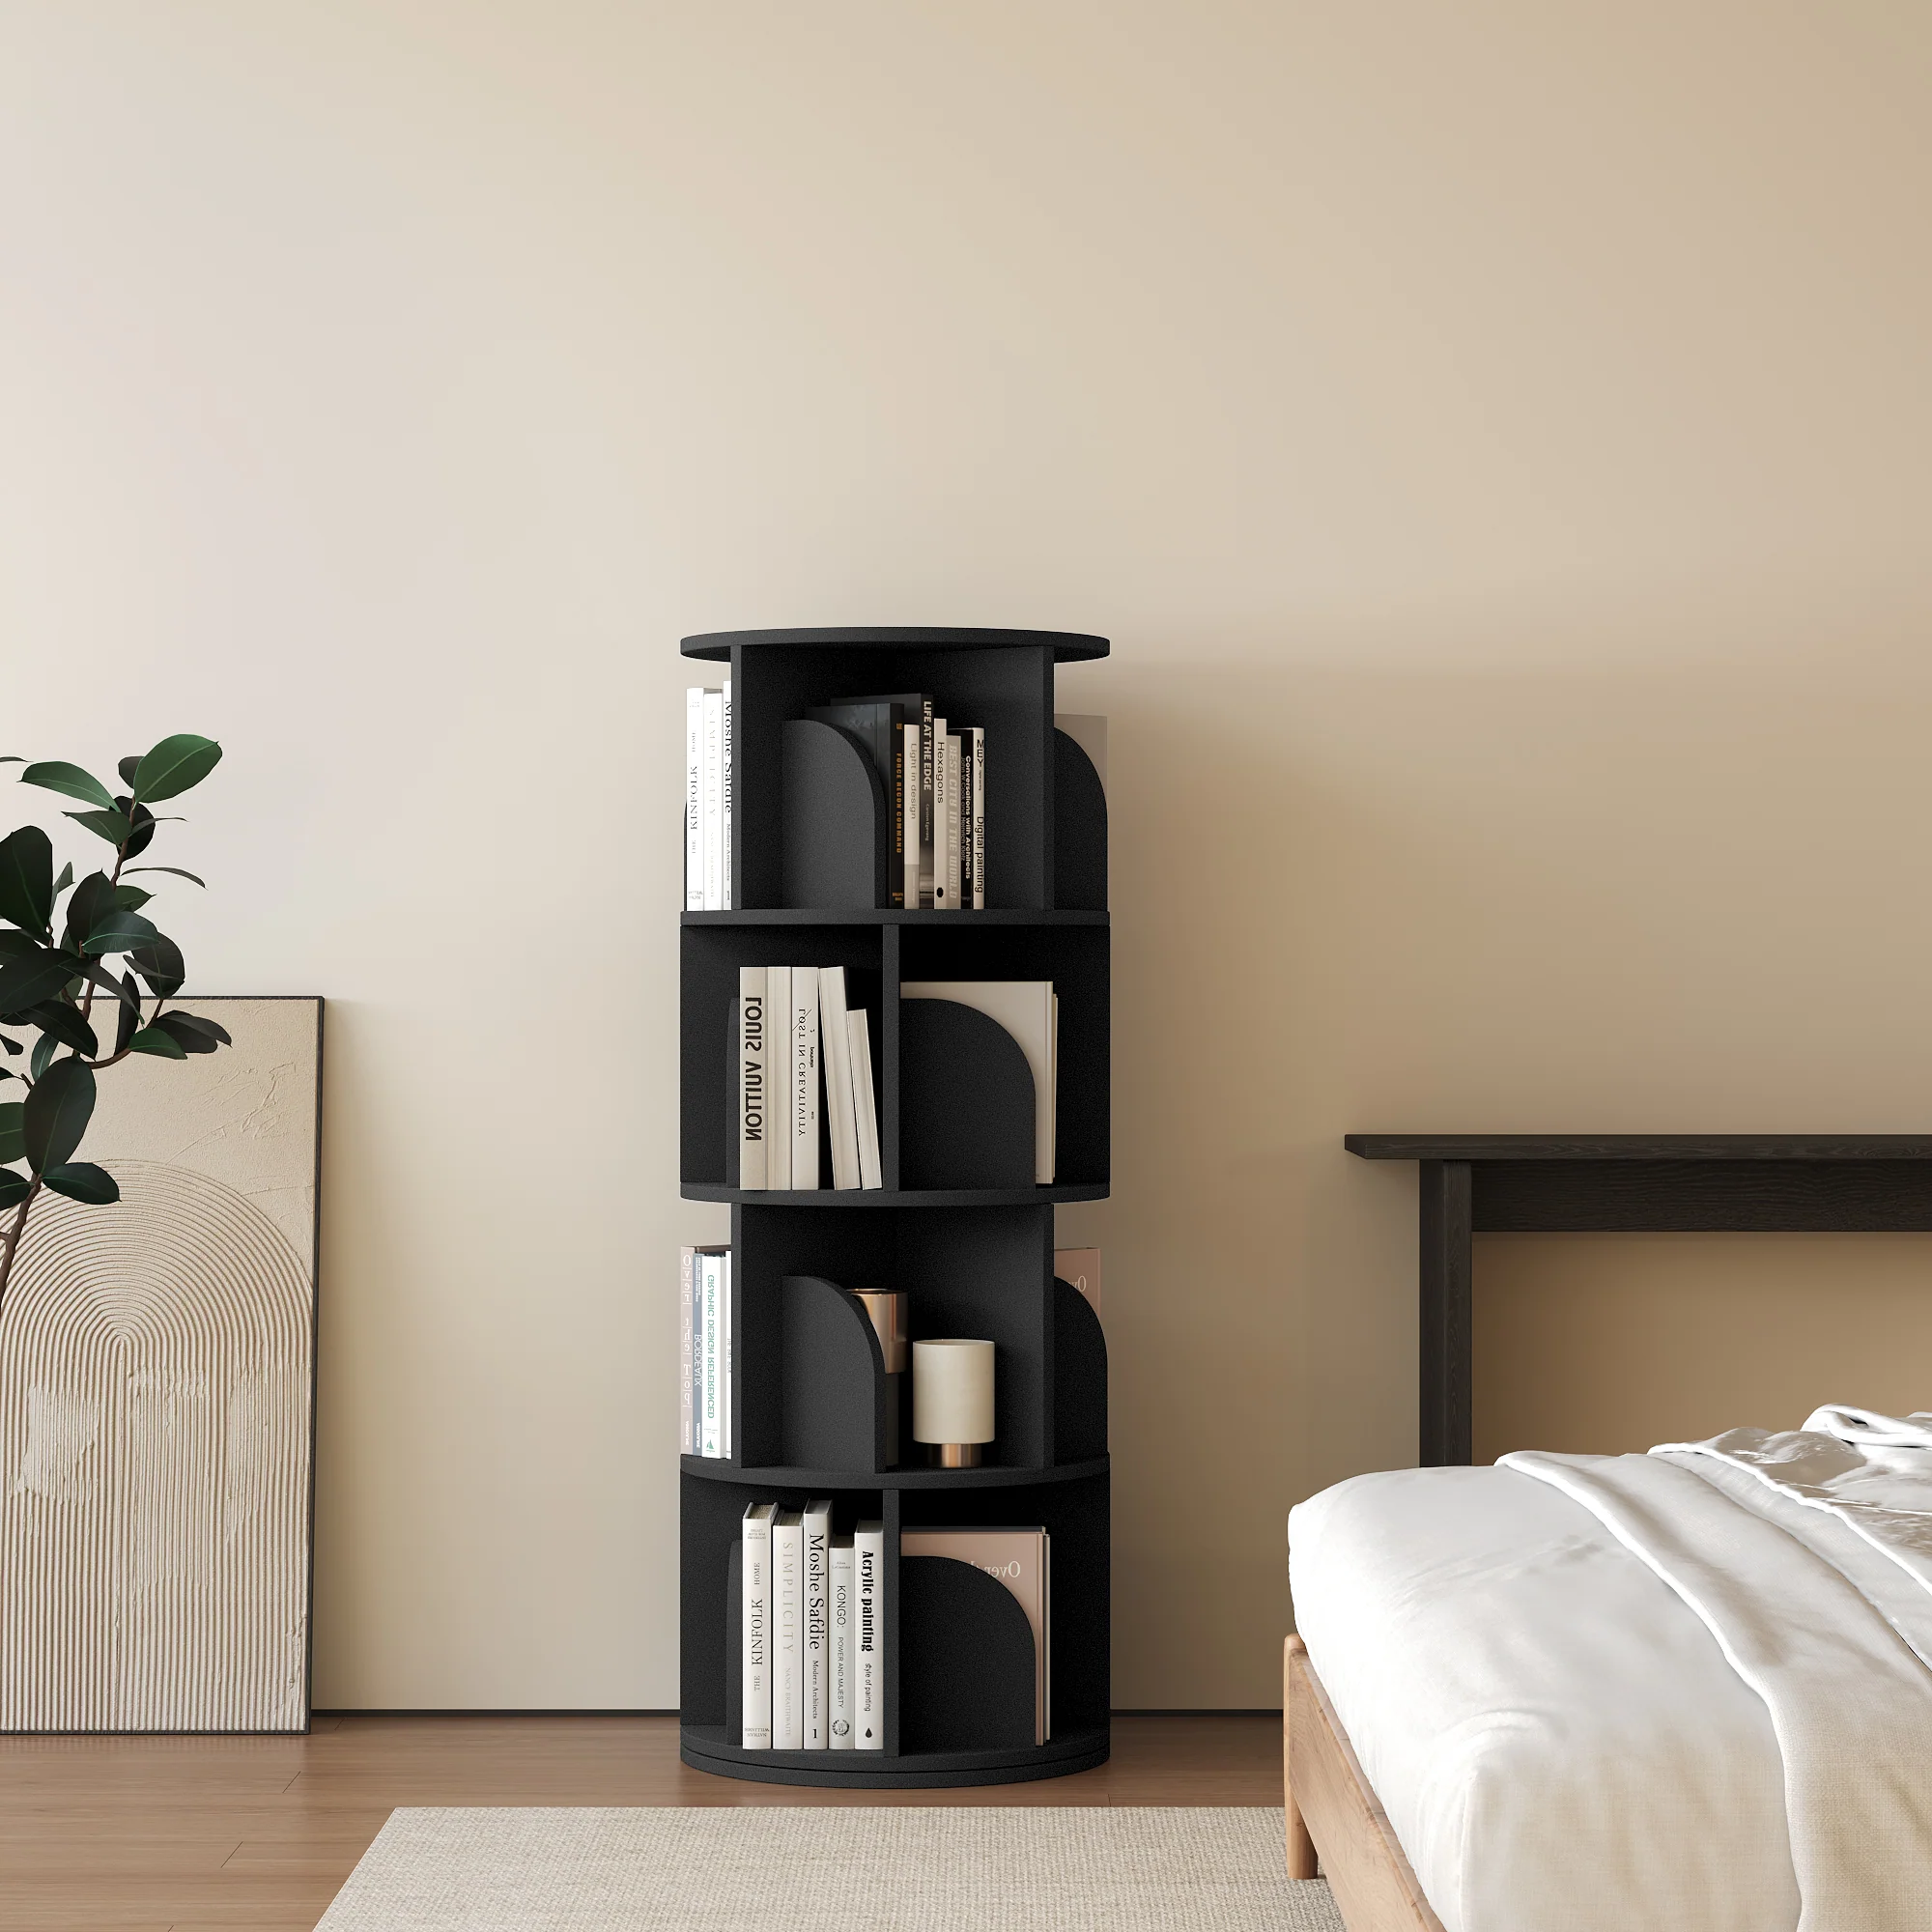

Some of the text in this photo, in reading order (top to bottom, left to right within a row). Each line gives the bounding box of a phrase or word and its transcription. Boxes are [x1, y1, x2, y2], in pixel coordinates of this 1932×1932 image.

[911, 773, 917, 781] in
[923, 701, 932, 791] LIFE AT THE EDGE
[936, 742, 945, 804] Hexagons
[950, 811, 957, 824] IN
[975, 816, 984, 894] Digital painting
[782, 1542, 793, 1653] SIMPLICITY
[810, 1534, 825, 1650] Moshe Safdie
[837, 1585, 846, 1628] KONGO:
[861, 1550, 874, 1652] Acrylic painting
[751, 1599, 763, 1666] KINFOLK
